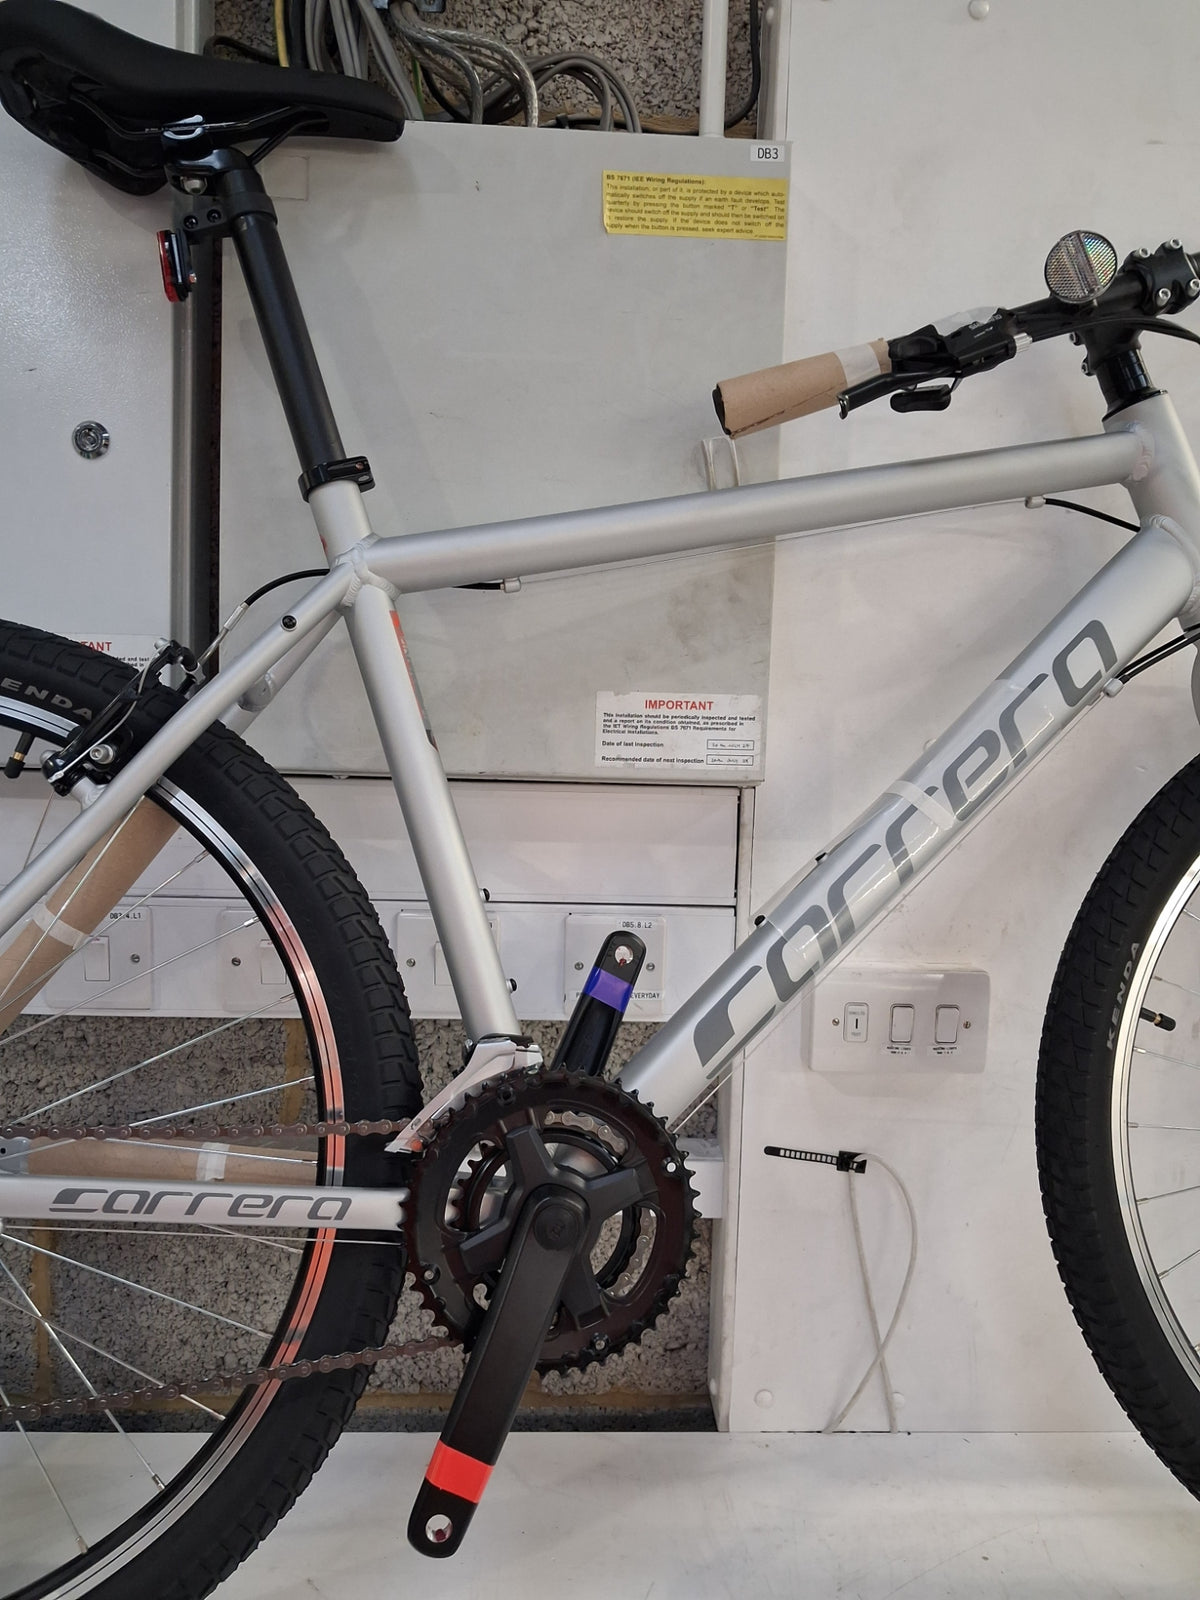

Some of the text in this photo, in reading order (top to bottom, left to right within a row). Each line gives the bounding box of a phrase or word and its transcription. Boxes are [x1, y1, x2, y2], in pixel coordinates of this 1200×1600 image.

[757, 147, 779, 160] DB3
[646, 176, 666, 184] Wiring
[0, 677, 92, 720] ENDA
[645, 699, 714, 711] IMPORTANT
[1107, 942, 1140, 1050] KENDA
